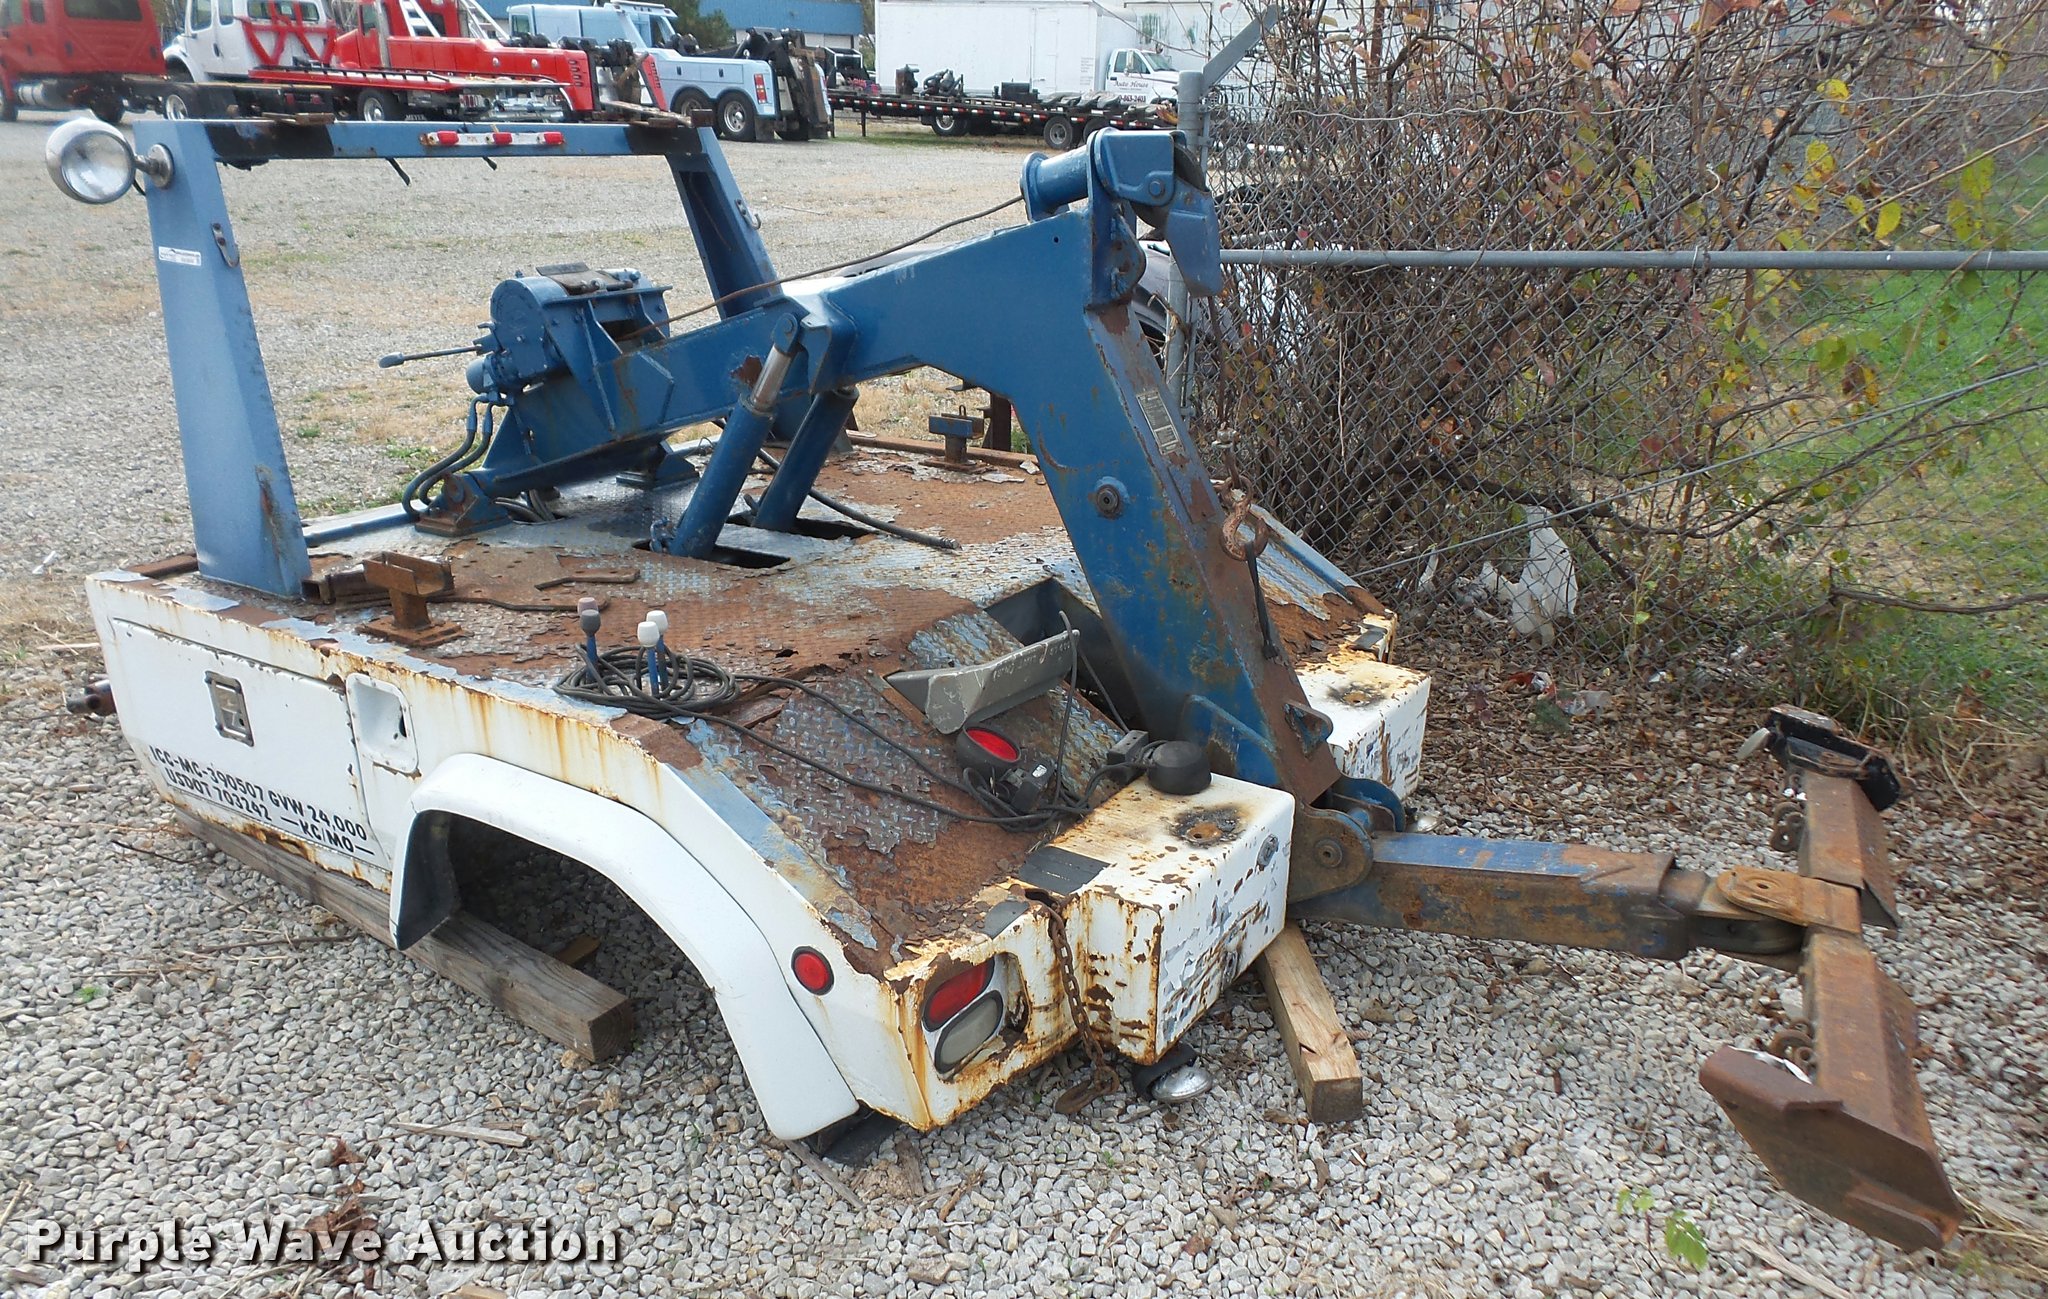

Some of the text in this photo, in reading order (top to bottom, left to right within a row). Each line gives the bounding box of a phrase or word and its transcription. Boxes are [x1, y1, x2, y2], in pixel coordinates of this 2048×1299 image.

[1130, 80, 1149, 88] House
[149, 745, 368, 841] ICC-MC-390507 GVW 24,000
[164, 767, 213, 798] USDOT
[213, 786, 273, 822] 703242
